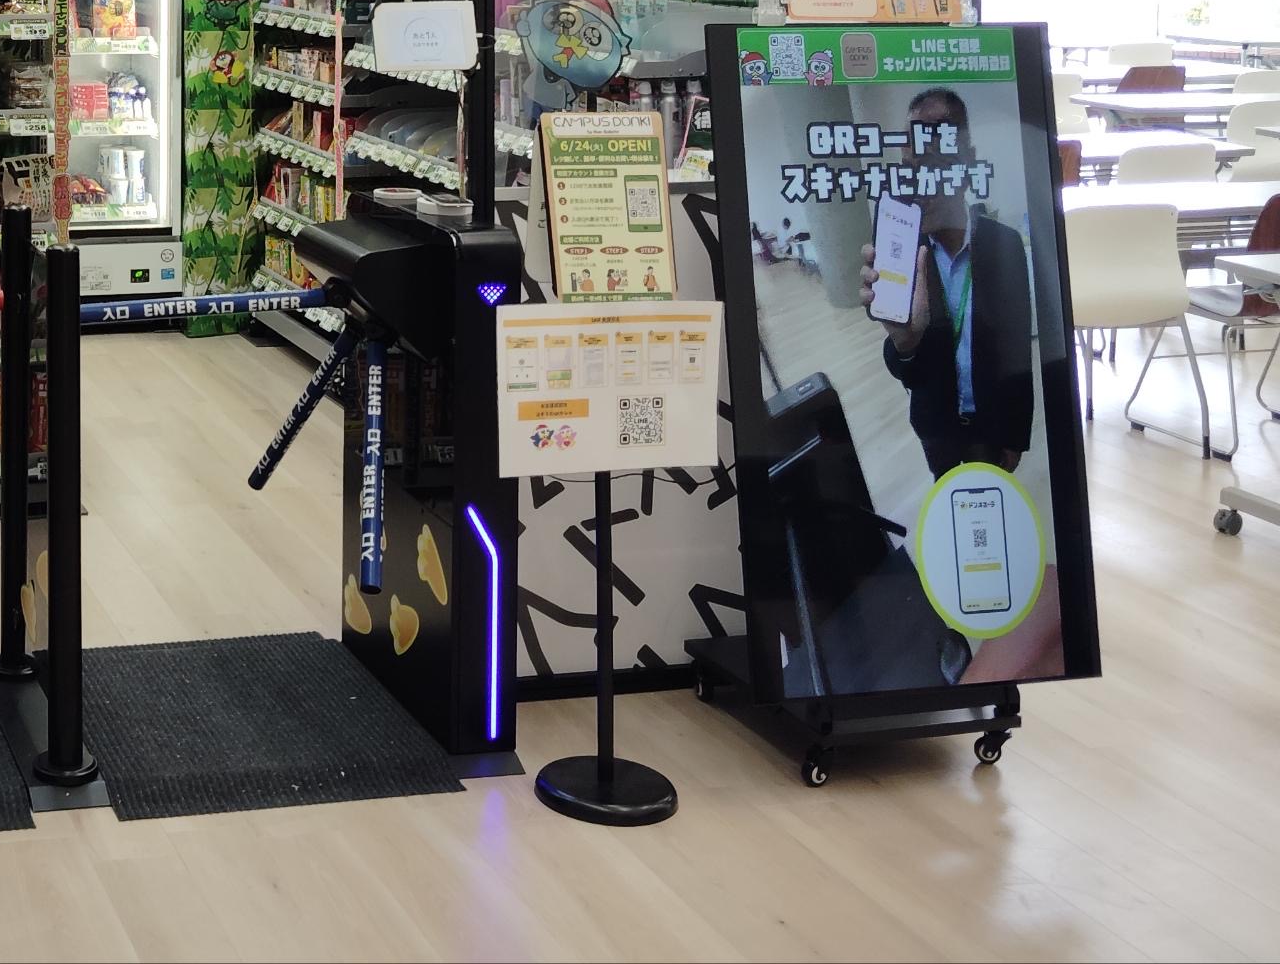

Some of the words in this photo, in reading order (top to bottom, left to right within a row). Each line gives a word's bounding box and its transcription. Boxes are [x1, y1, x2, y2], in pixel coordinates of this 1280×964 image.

[553, 116, 610, 128] CAMPUS
[613, 116, 651, 126] DONKI
[608, 140, 652, 152] OPEN!
[809, 123, 959, 155] QRコードを
[782, 164, 993, 200] スキャナにかざす
[102, 307, 130, 321] 入口
[144, 300, 197, 317] ENTER
[207, 301, 235, 315] 入口
[248, 296, 301, 312] ENTER
[368, 364, 382, 415] ENTER
[362, 464, 376, 519] ENTER
